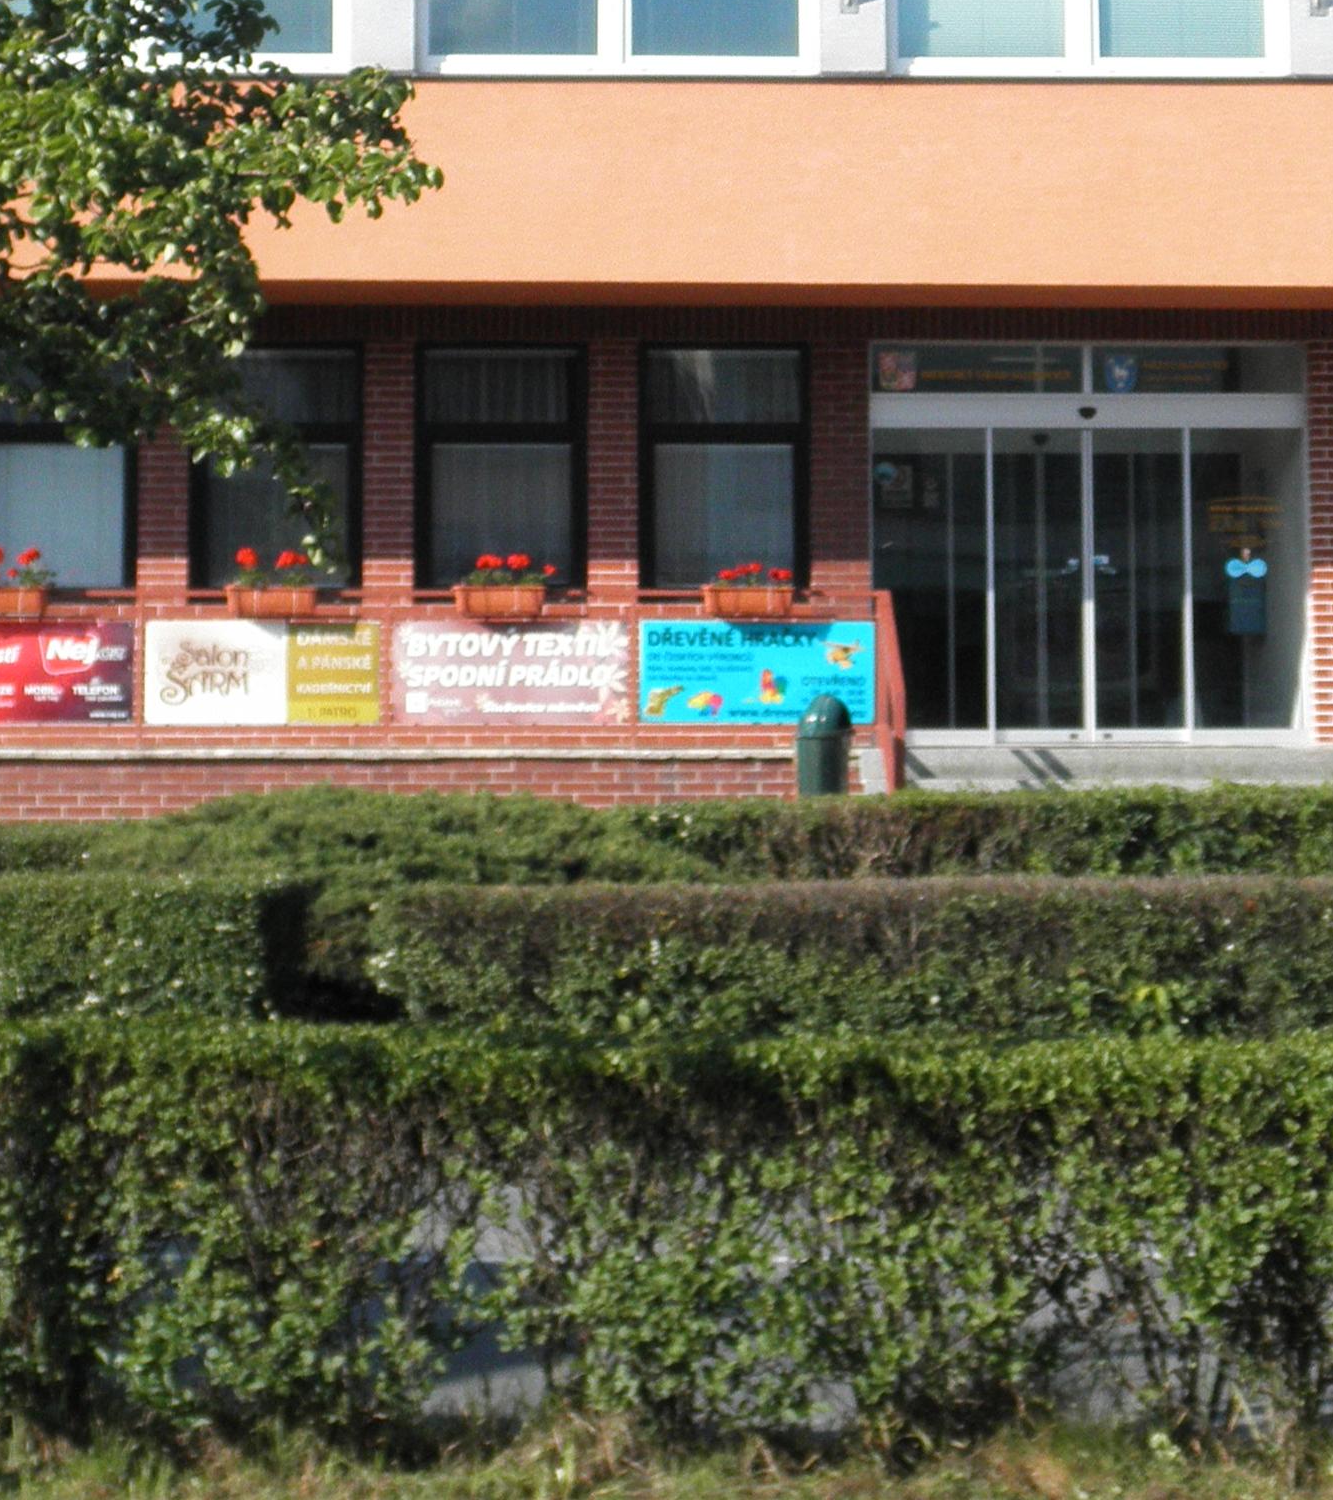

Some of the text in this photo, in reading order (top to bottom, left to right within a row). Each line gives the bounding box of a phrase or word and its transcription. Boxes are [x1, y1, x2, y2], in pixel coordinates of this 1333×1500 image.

[405, 628, 613, 657] BYTOVÝ TEXTIL
[646, 627, 735, 648] DŘEVĚNÉ
[178, 640, 250, 668] Salon
[297, 655, 309, 669] A
[405, 658, 613, 687] SPODNÍ PRÁDLO
[71, 684, 119, 696] TELEFON
